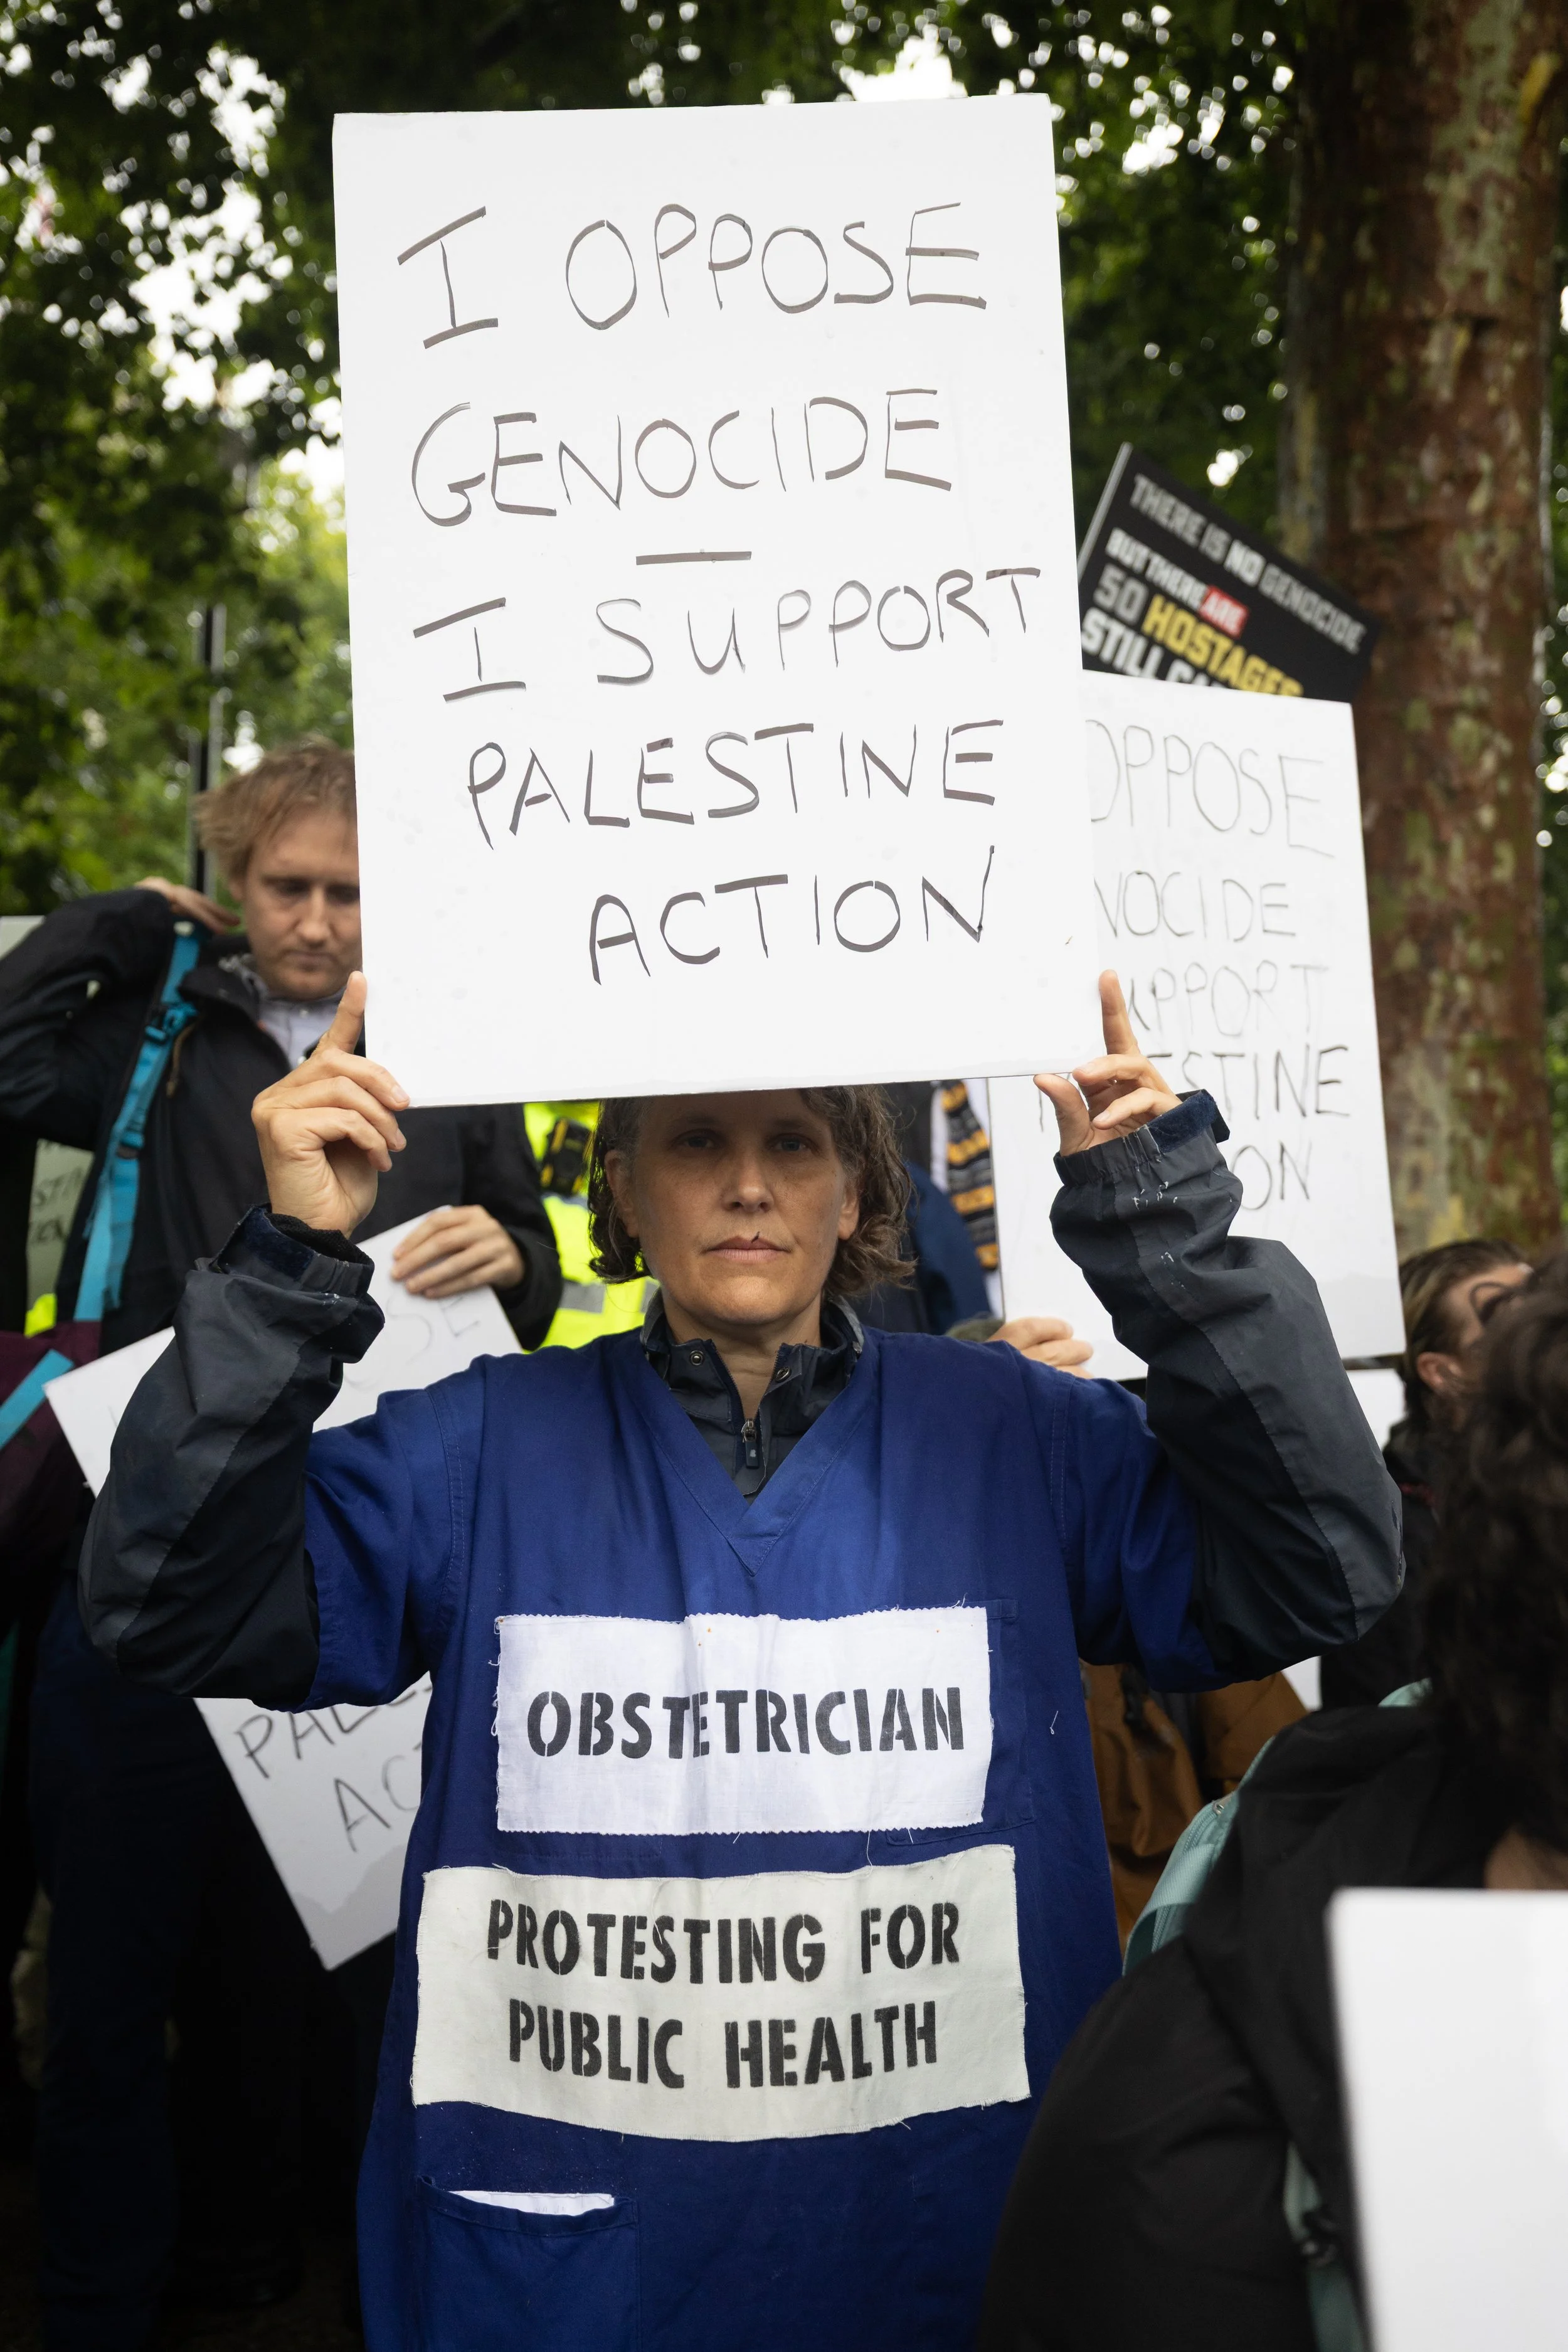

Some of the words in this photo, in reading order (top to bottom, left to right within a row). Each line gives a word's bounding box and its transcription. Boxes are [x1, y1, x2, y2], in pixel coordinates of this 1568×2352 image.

[396, 205, 499, 350] I
[565, 201, 987, 331] OPPOSE
[411, 388, 952, 527] GENOCIDE
[1104, 527, 1150, 575] BUT
[1145, 551, 1208, 611] THERE
[1200, 593, 1247, 635] ARE
[1130, 473, 1207, 546] THERE
[1199, 522, 1232, 564] IS
[1224, 539, 1266, 586] NO
[1258, 564, 1367, 655] GENOCIDE
[412, 596, 527, 704] I
[595, 568, 1041, 687] SUPPORT
[1080, 607, 1164, 680] STILL
[467, 719, 1005, 851] PALESTINE
[589, 844, 995, 986] ACTION
[1093, 869, 1297, 943] NOCIDE
[1130, 959, 1330, 1039] PPORT
[527, 1687, 965, 1760] OBSTETRICIAN
[487, 1899, 826, 1985] PROTESTING
[860, 1900, 960, 1975] FOR
[509, 1998, 685, 2089] PUBLIC
[724, 2000, 938, 2089] HEALTH
